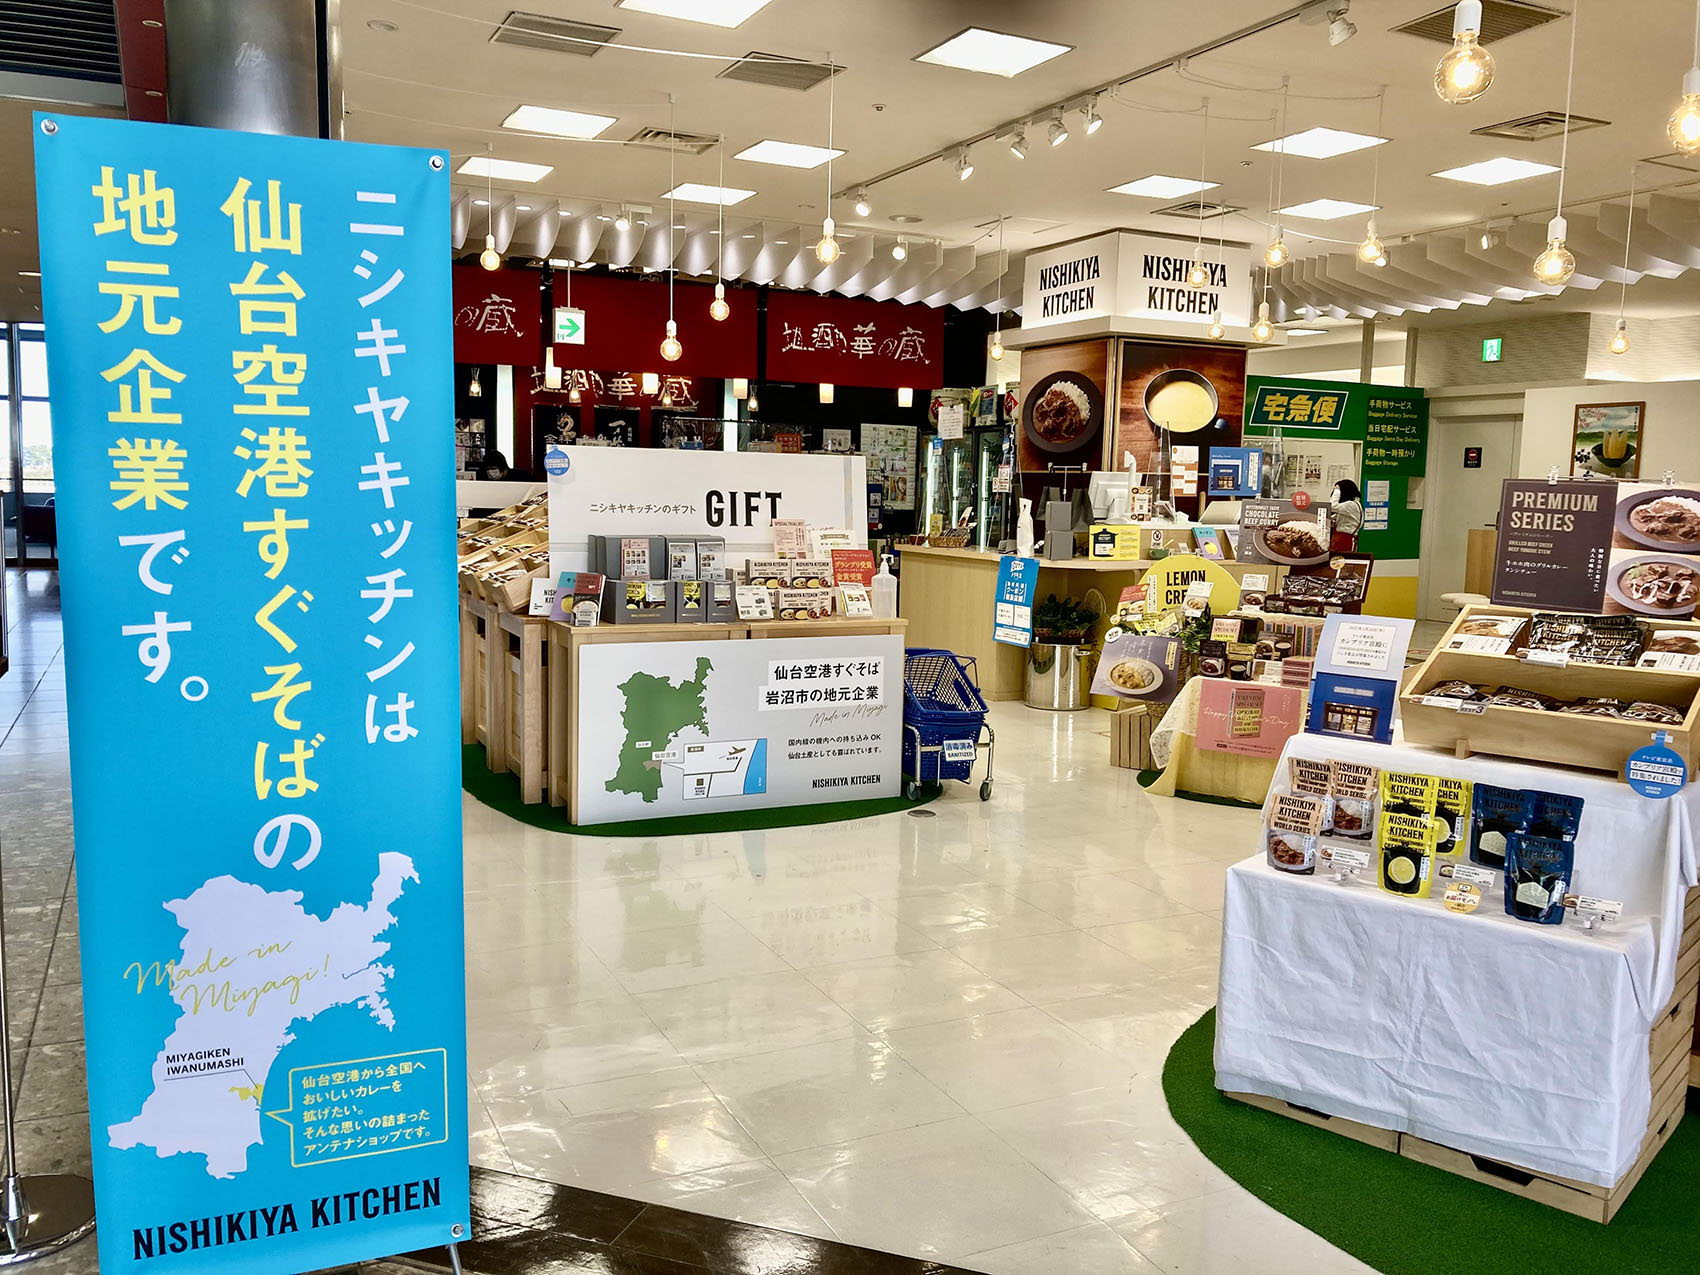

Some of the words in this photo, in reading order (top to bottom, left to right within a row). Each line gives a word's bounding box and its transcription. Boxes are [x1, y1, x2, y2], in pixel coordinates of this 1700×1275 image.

[1040, 255, 1100, 291] NISHIKIYA
[1143, 254, 1227, 287] NISHIYA
[1043, 286, 1095, 318] KITCHEN
[1147, 286, 1219, 315] KITCHEN
[1261, 392, 1339, 424] 宅急便
[1369, 399, 1412, 410] 手荷物サービス
[91, 165, 209, 702] 地元企業です。
[1368, 424, 1417, 434] 当日宅配サービス
[1366, 448, 1415, 458] 手荷物一時預かり
[350, 190, 418, 744] ニシキヤキッチンは
[590, 503, 697, 515] ニシキヤキッチンのギフト
[706, 489, 782, 527] GIFT
[1512, 491, 1599, 512] PREMIUM
[220, 176, 325, 871] 仙台空港すぐそばの
[1244, 517, 1258, 525] BEEF
[1245, 510, 1279, 519] CHOCOLATE
[1510, 511, 1575, 532] SERIES
[834, 561, 872, 569] グランプリ受賞
[1166, 570, 1206, 586] LEMON
[774, 661, 881, 680] 仙台空港すぐそば
[765, 685, 879, 705] 岩沼市の地元企業
[810, 710, 839, 727] Made
[788, 734, 869, 746] 国内線の機内への持ち込み
[1296, 760, 1331, 773] NISHIKIYA
[1300, 770, 1328, 782] KITCHEN
[812, 776, 848, 789] NISHIKIYA
[850, 774, 881, 786] KITCHEN
[1389, 774, 1429, 787] NISHIKIYA
[1391, 785, 1424, 797] KITCHEN
[1279, 796, 1316, 811] NISHIKIYA
[1279, 807, 1311, 820] KITCHEN
[1388, 815, 1428, 830] NISHIKIYA
[1274, 822, 1293, 832] WORLD
[1293, 825, 1311, 835] SERIES
[1389, 827, 1424, 840] KITCHEN
[122, 952, 237, 996] Made
[248, 938, 293, 962] in
[181, 953, 331, 1017] Miyagi!
[165, 1047, 231, 1065] MIYAGIKEN
[166, 1057, 245, 1076] IWANUMASHI
[302, 1061, 426, 1089] 仙台空港から全国へ
[303, 1080, 402, 1106] おいしいカレーを
[303, 1104, 364, 1123] 拡げたい。
[303, 1109, 431, 1140] そんな思いの詰まった
[303, 1126, 431, 1157] アンテナショップです。
[132, 1202, 299, 1261] NISHIKIYA
[311, 1176, 442, 1231] KITCHEN
